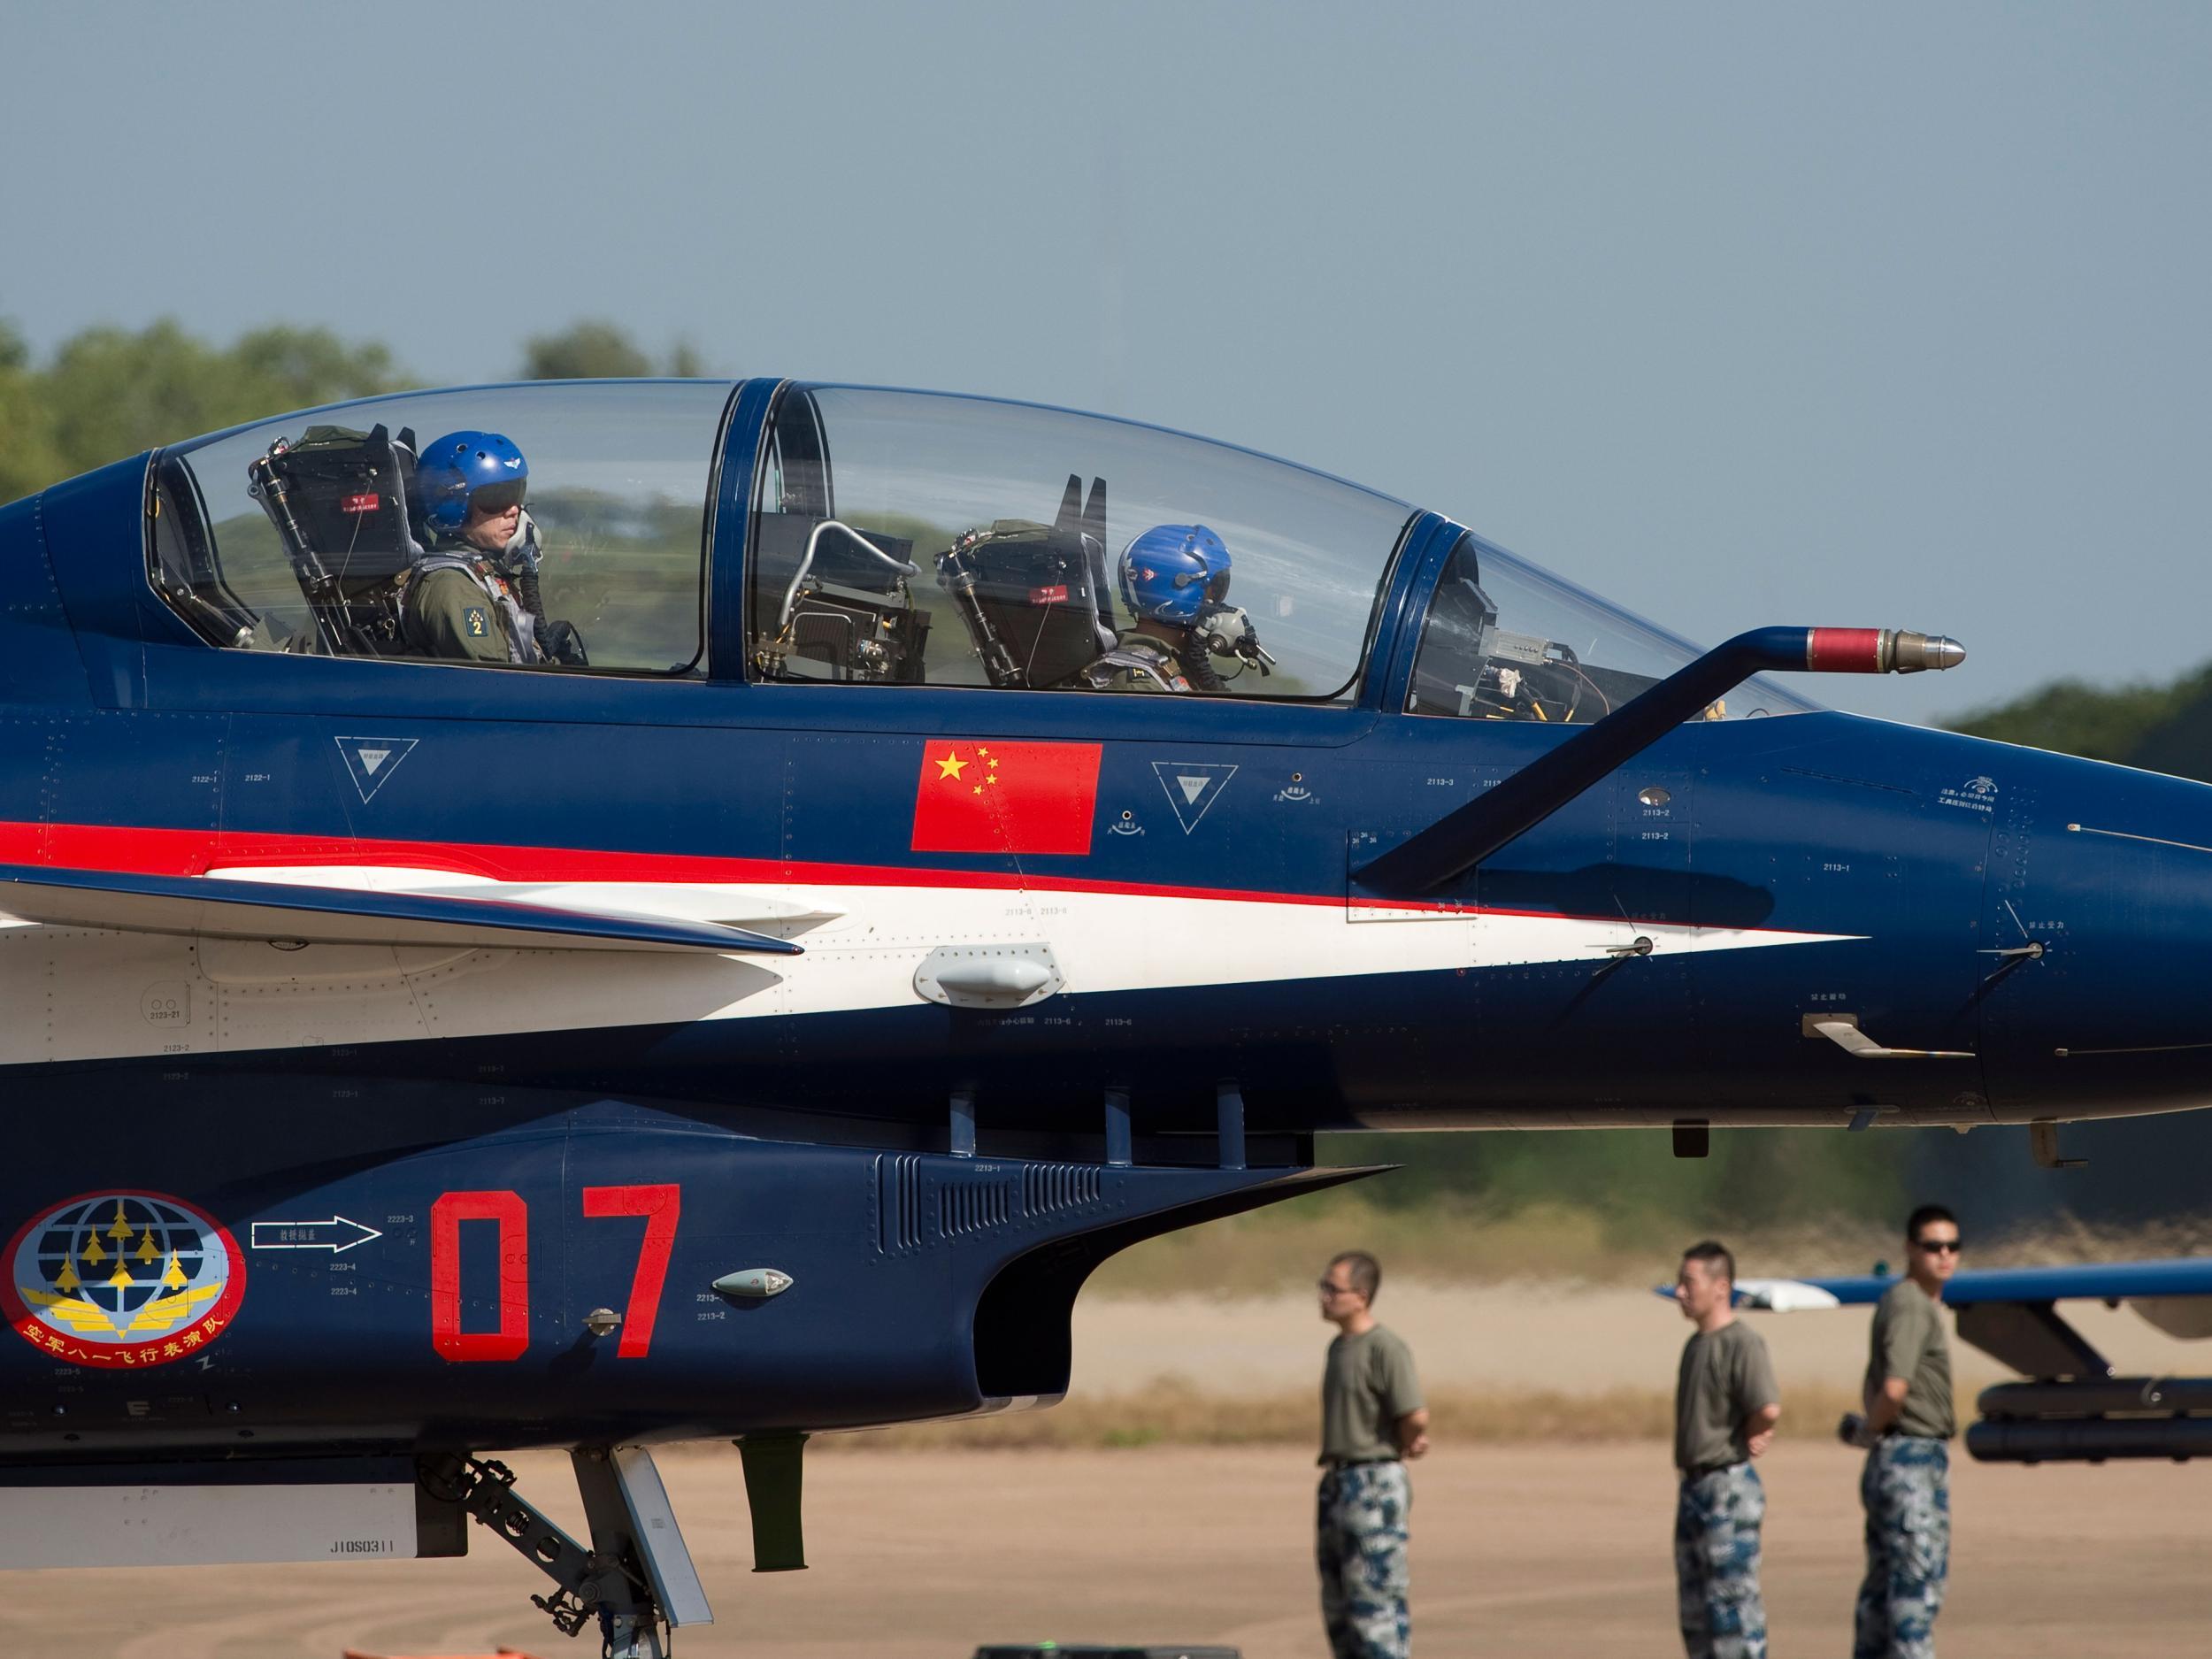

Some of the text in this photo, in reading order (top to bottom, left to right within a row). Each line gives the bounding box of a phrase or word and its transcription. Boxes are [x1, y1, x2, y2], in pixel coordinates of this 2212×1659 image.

[473, 621, 482, 634] 2
[192, 775, 217, 784] 2122-1
[1426, 778, 1454, 787] 2113-3
[1641, 832, 1669, 841] 2113-2
[1824, 863, 1850, 872] 2113-1
[150, 1010, 180, 1020] 2123-21
[163, 1044, 189, 1053] 2123-2
[388, 1214, 414, 1223] 2223-3
[330, 1263, 357, 1271] 2223-4
[431, 1183, 680, 1361] 07
[331, 1287, 357, 1296] 2223-4
[696, 1294, 723, 1302] 2213-
[697, 1310, 726, 1321] 2213-2
[22, 1317, 225, 1363] 空军八一飞行表演队
